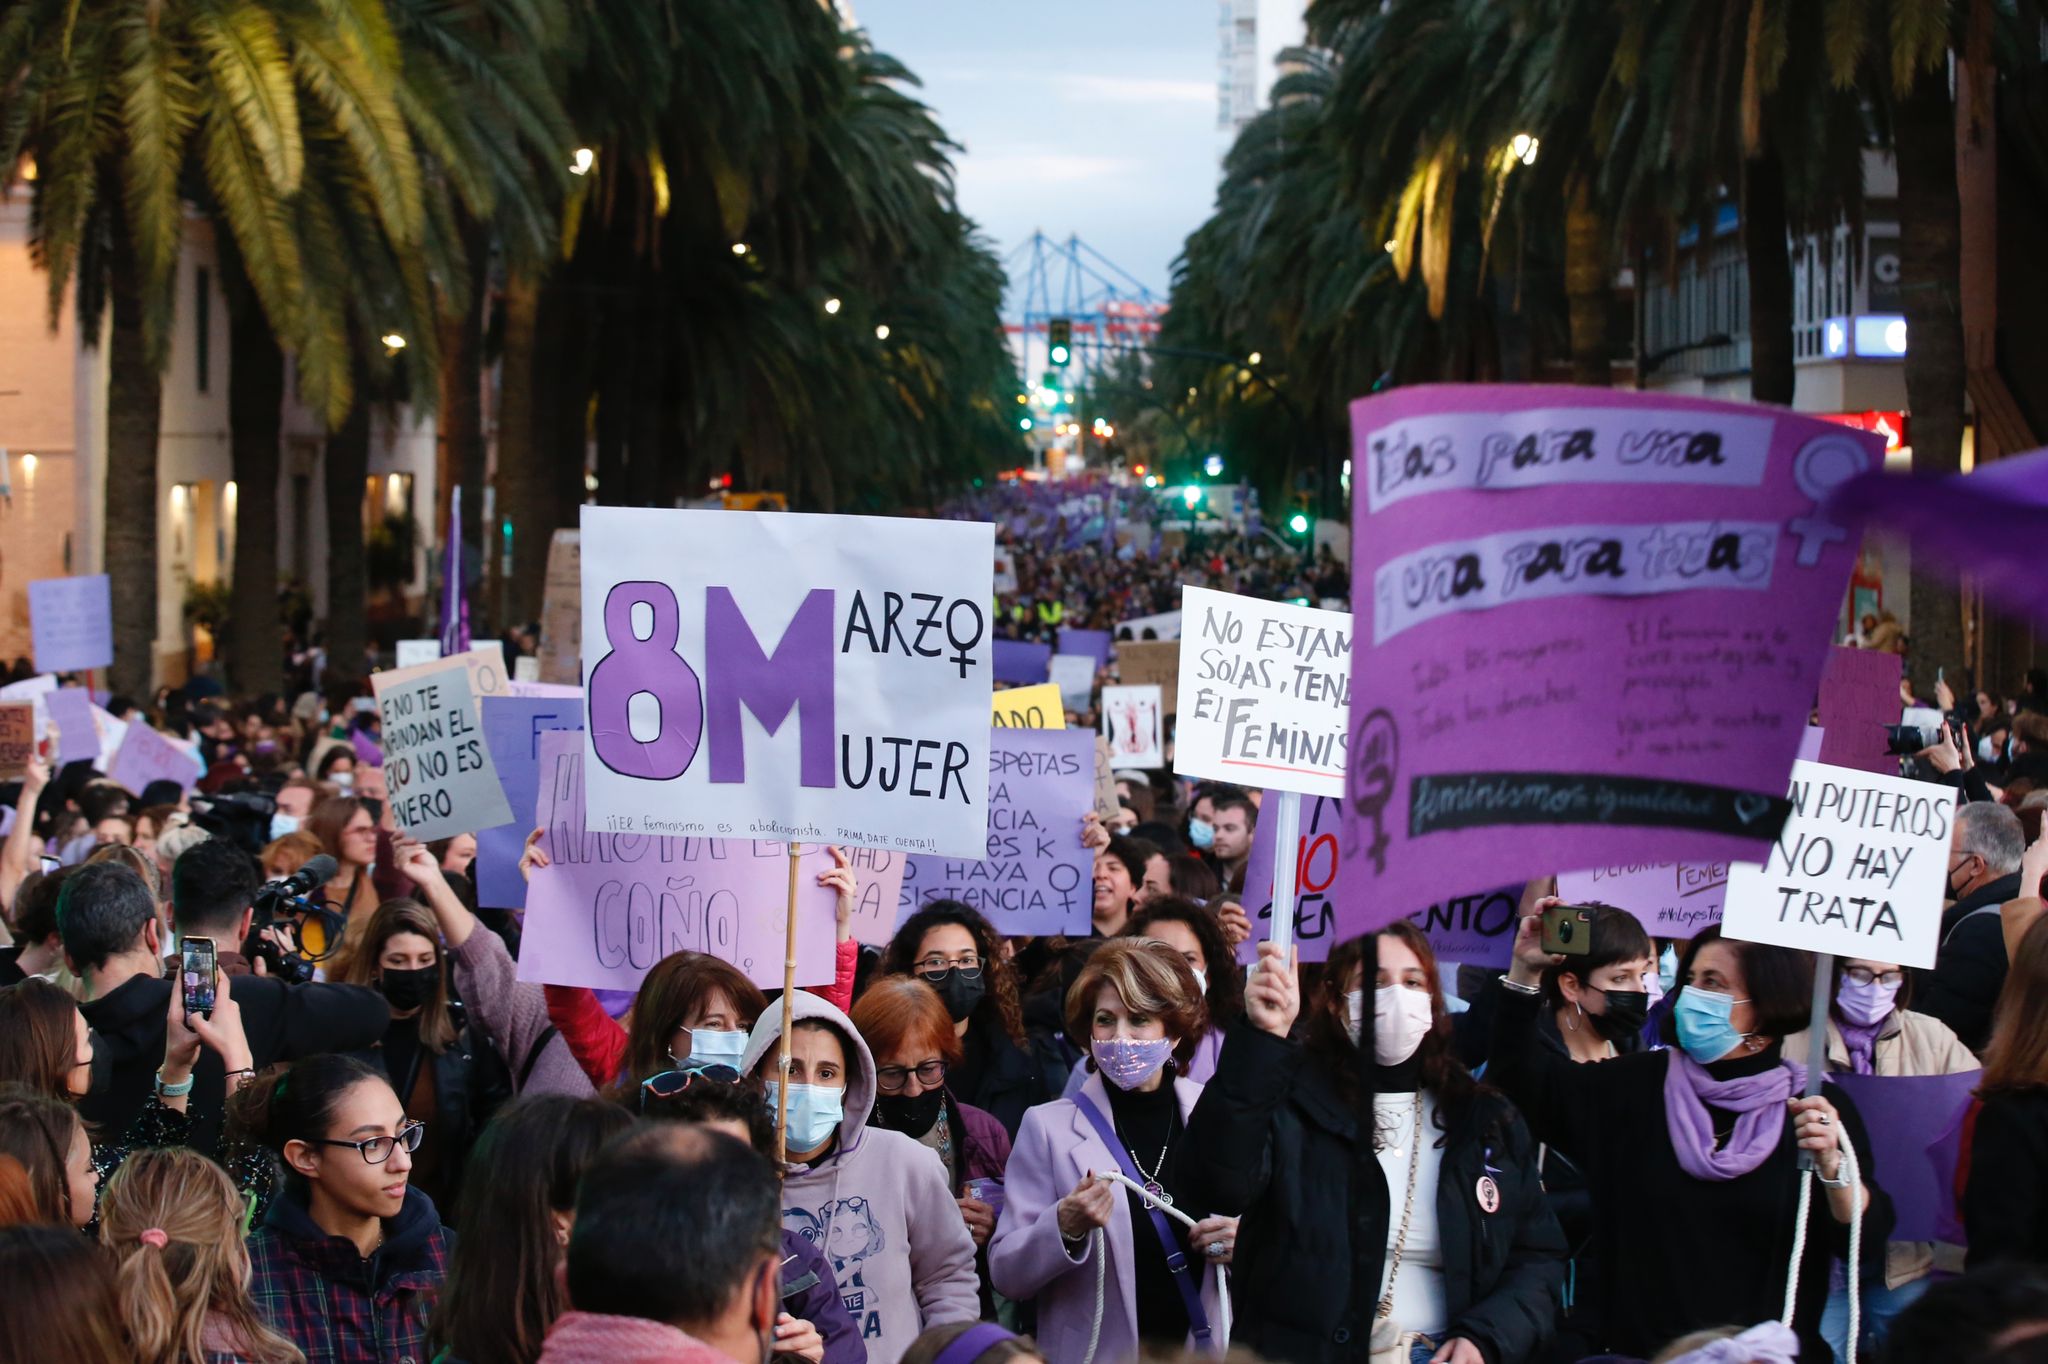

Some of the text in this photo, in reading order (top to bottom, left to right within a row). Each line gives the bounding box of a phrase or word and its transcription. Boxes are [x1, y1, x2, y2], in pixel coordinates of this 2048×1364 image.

[1476, 428, 1596, 488] para
[1616, 429, 1728, 468] una
[1202, 606, 1243, 645] NO
[416, 684, 441, 711] TE
[449, 708, 475, 738] EL
[417, 750, 449, 784] NO
[456, 739, 484, 774] ES
[842, 732, 971, 805] UJER
[643, 814, 705, 832] feminismo
[717, 822, 733, 833] es
[1412, 776, 1584, 835] feminismo
[1814, 782, 1952, 841] PUTEROS
[945, 860, 1029, 883] HAYA
[1761, 832, 1913, 890] NO HAY
[1777, 886, 1904, 941] TRATA
